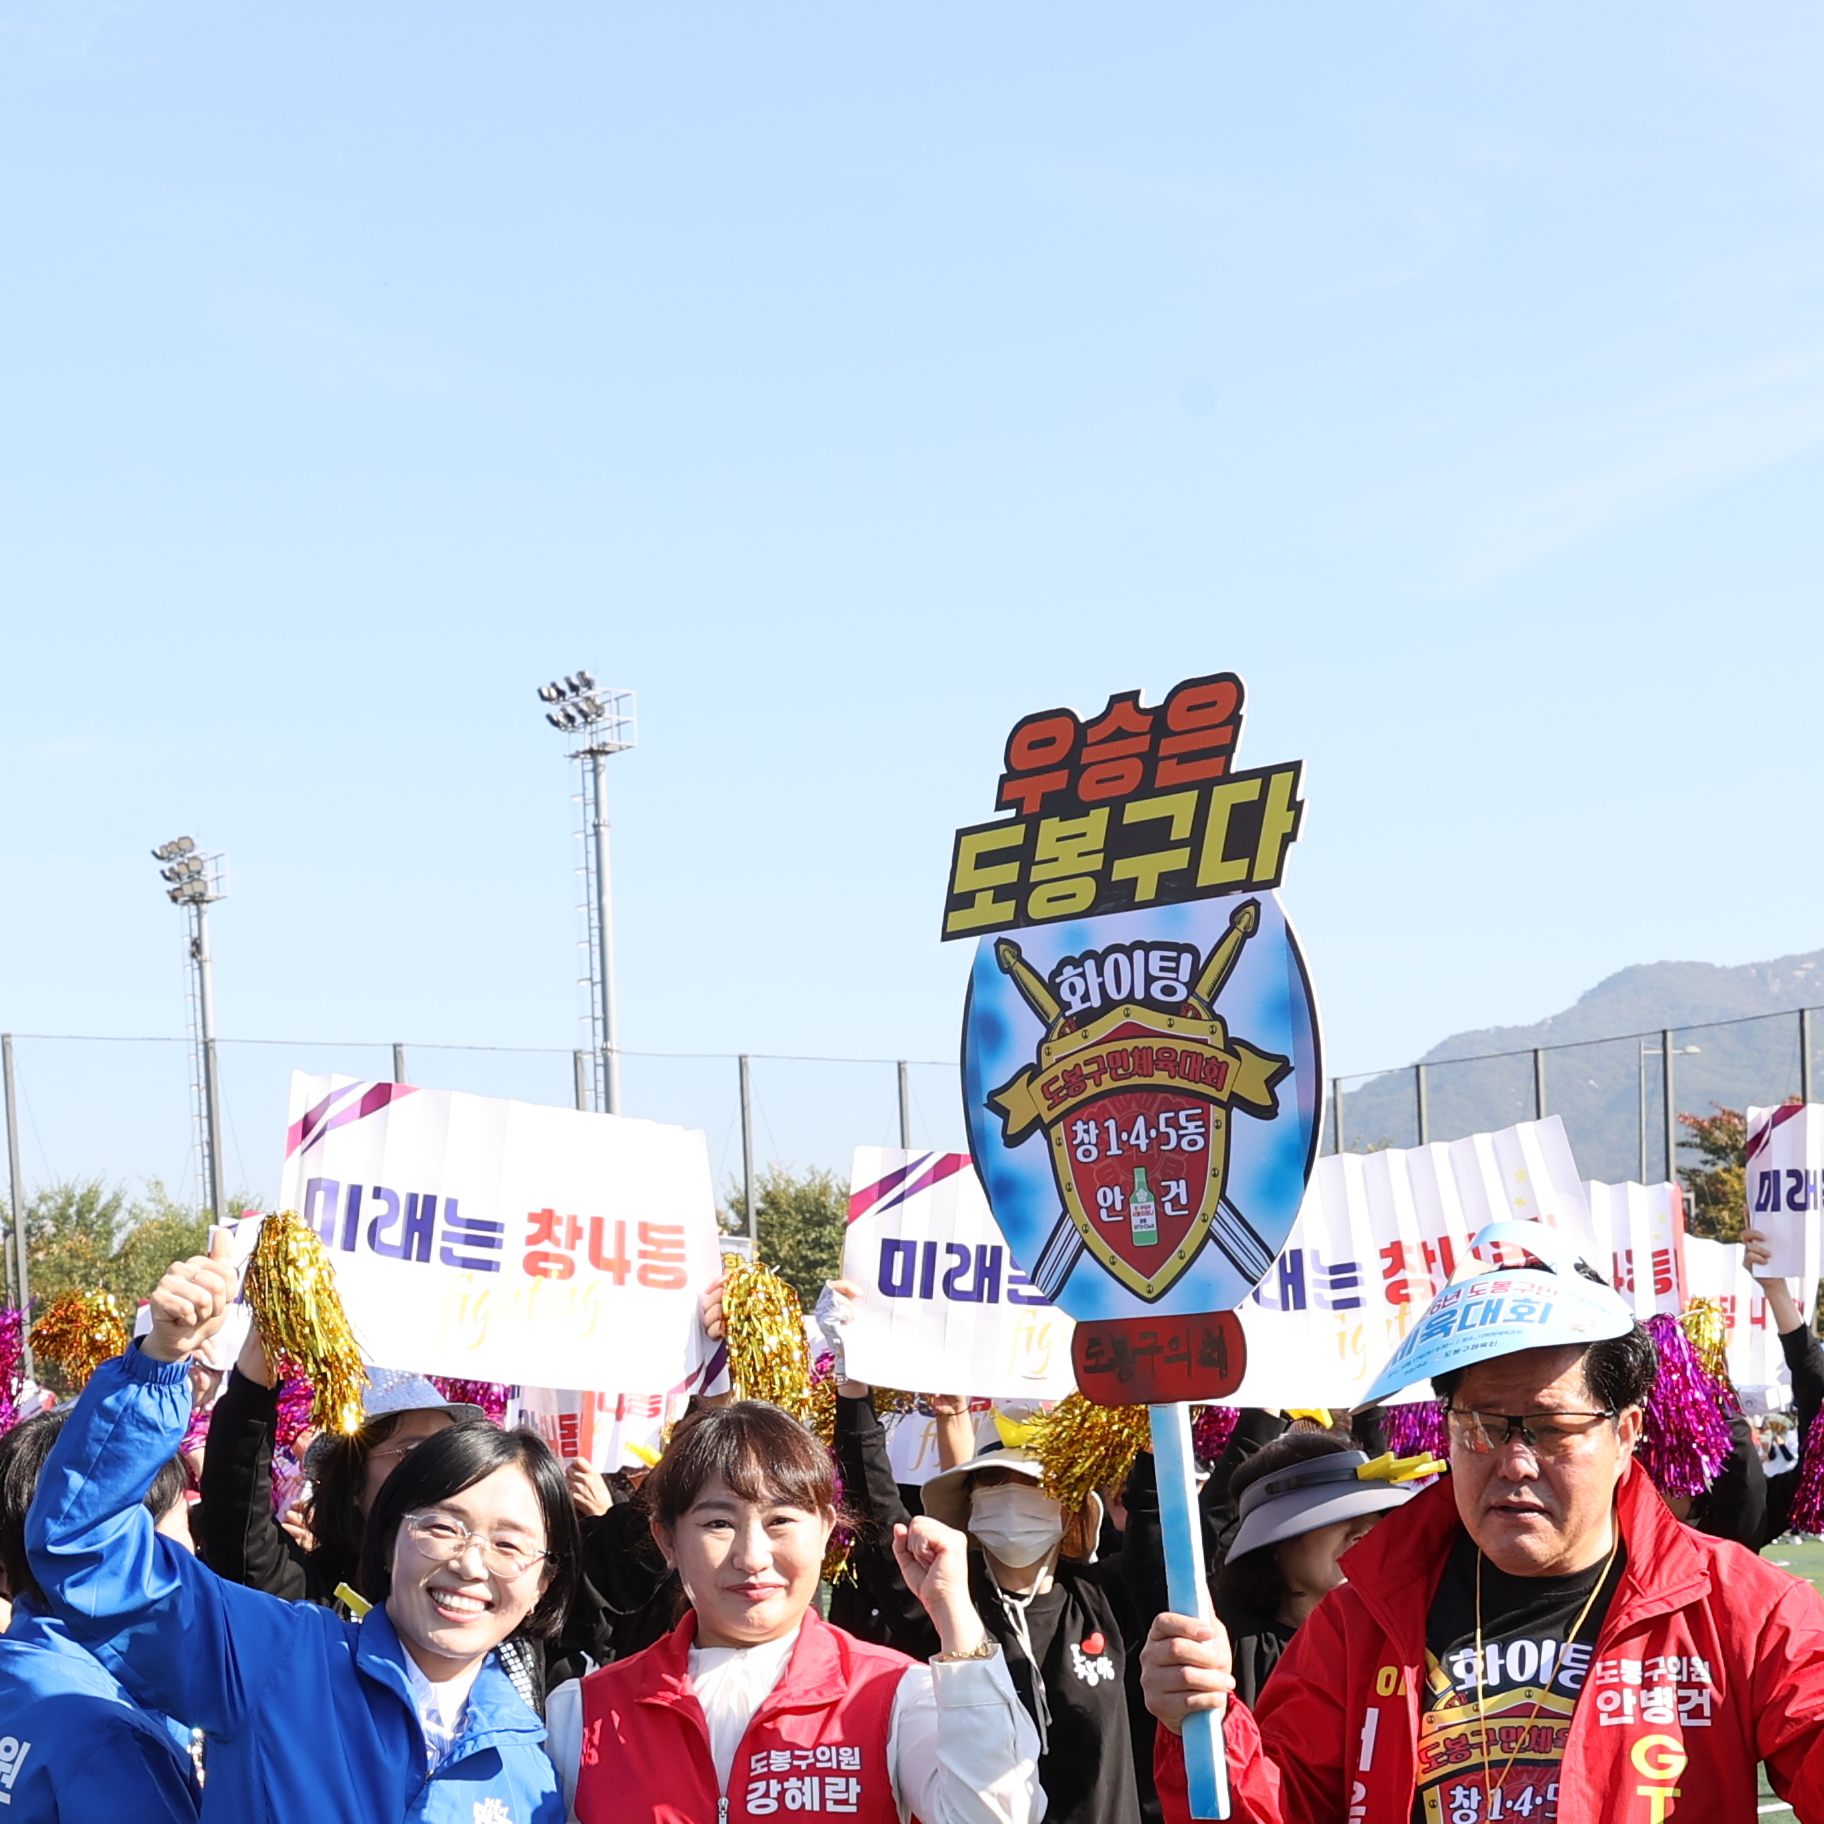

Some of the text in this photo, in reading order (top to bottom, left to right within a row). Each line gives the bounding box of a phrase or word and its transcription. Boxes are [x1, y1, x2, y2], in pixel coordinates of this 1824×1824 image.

[1001, 680, 1239, 815] 우승은
[945, 770, 1296, 933] 도봉구다
[1055, 948, 1195, 1018] 화이팅
[1040, 1046, 1230, 1109] 도봉구민체육대회
[1096, 1178, 1190, 1222] 안 건
[306, 1176, 689, 1291] 미래는 창4동
[1466, 1280, 1559, 1299] 도봉구민
[1595, 1655, 1713, 1686] 도봉구의원
[1596, 1686, 1713, 1727] 안병건
[749, 1745, 862, 1778] 도봉구의원
[745, 1776, 862, 1816] 강혜란
